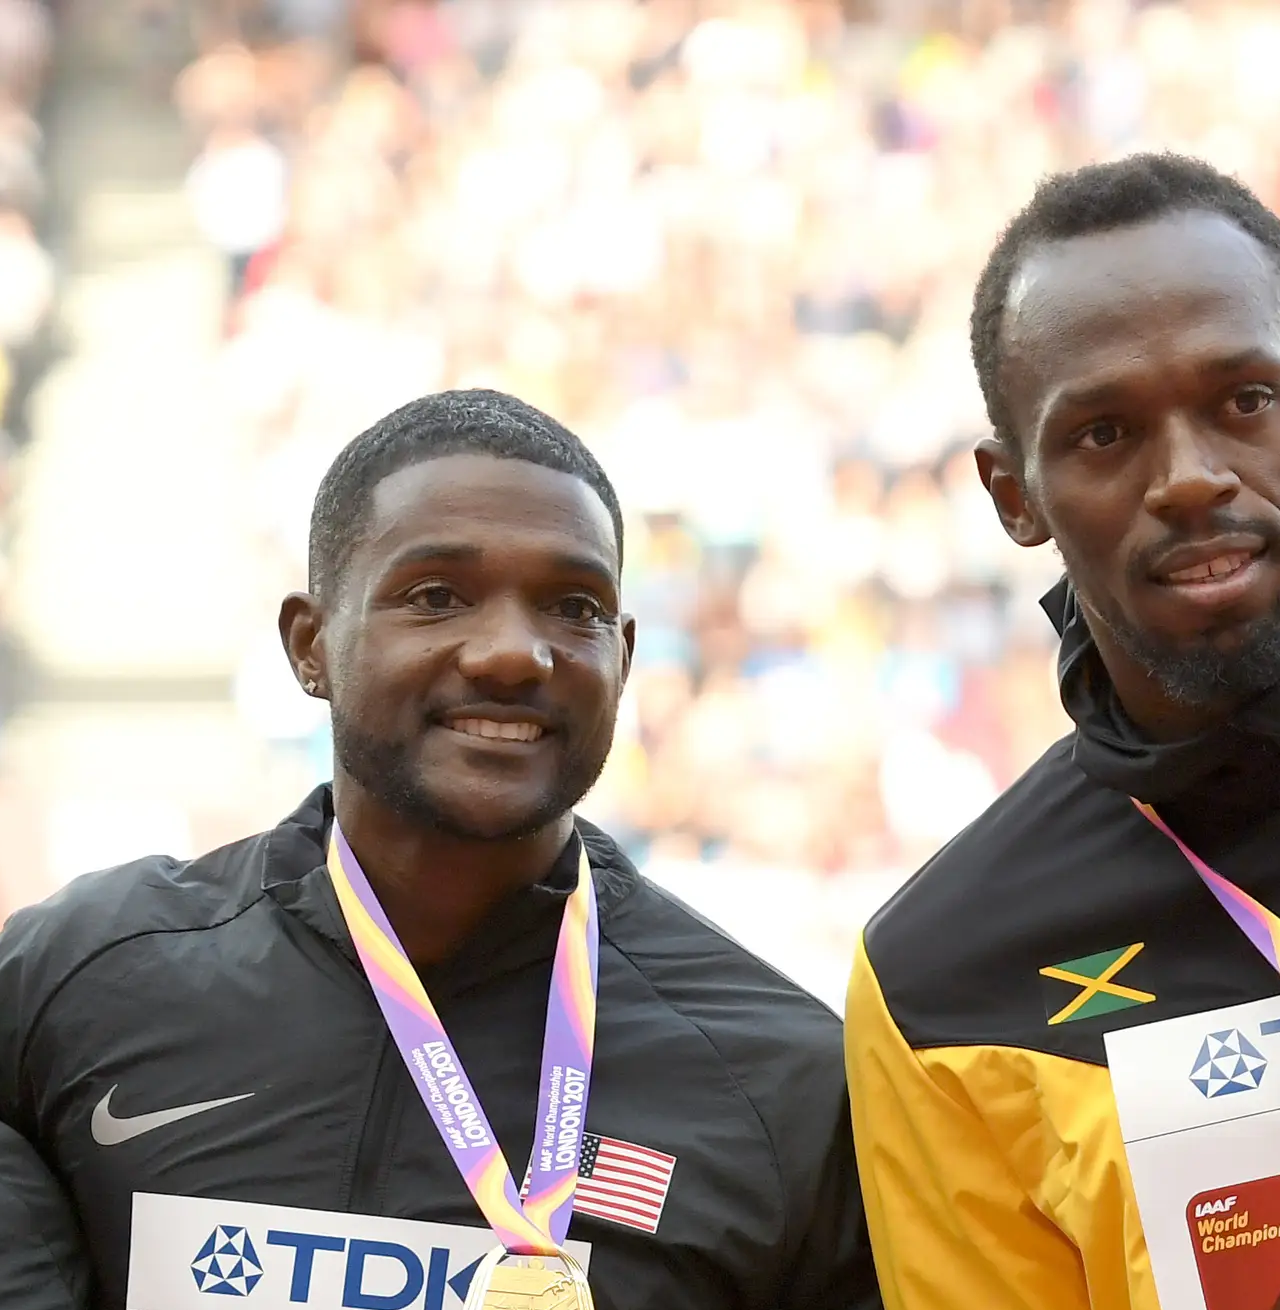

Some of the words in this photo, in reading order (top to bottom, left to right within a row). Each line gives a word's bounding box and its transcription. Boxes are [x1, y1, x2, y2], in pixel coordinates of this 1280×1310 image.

[422, 1041, 457, 1078] 2017
[412, 1048, 444, 1103] Championships
[562, 1066, 586, 1104] 2017
[545, 1066, 563, 1123] Championships
[434, 1103, 456, 1126] World
[440, 1075, 491, 1148] LONDON
[446, 1126, 468, 1149] IAAF
[542, 1125, 556, 1147] World
[554, 1104, 581, 1171] LONDON
[540, 1149, 553, 1172] IAAF
[1194, 1195, 1237, 1217] IAAF
[1197, 1211, 1249, 1237] World
